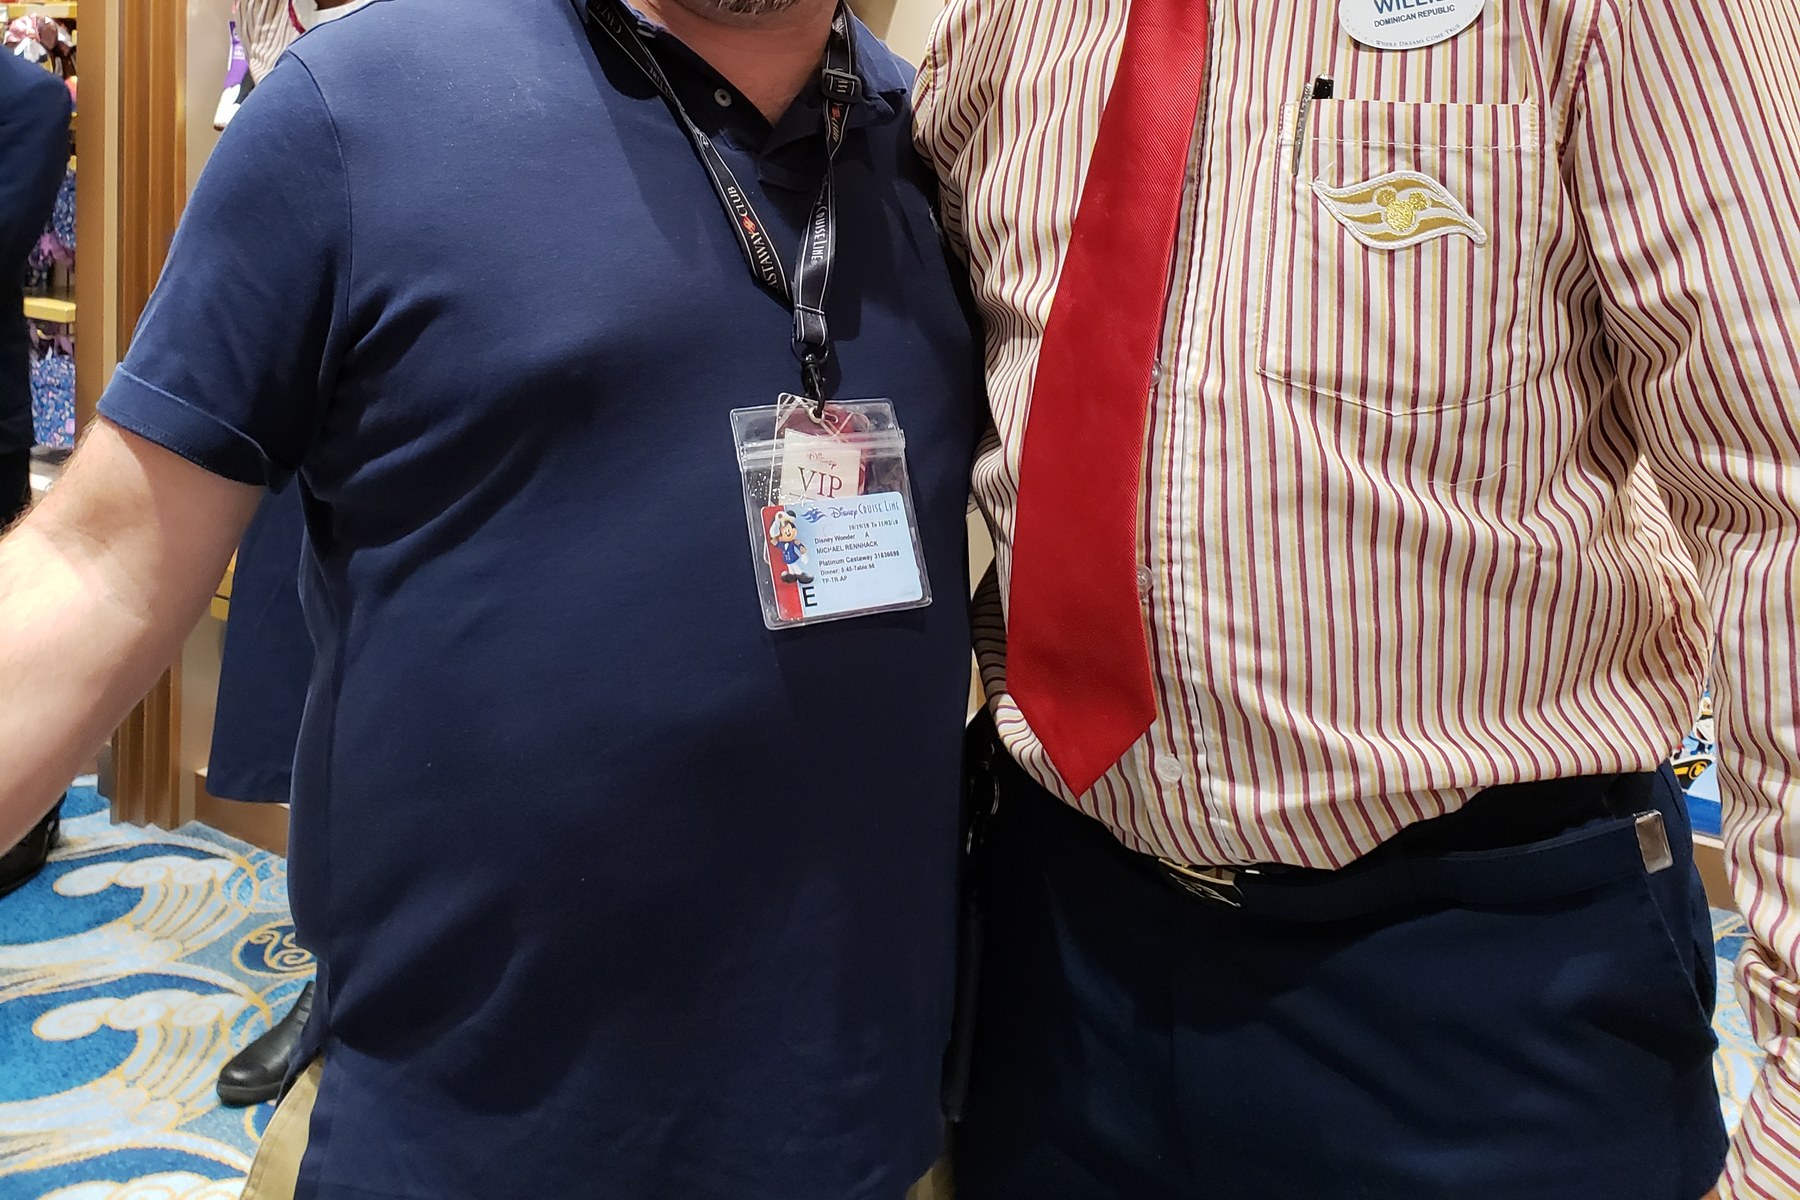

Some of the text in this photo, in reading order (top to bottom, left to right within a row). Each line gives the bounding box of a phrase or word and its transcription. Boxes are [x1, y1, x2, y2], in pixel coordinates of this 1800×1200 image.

[1373, 4, 1456, 28] DOMINICAN REPUBLIC
[727, 186, 748, 217] CLUB
[811, 239, 828, 260] LINE
[798, 466, 843, 499] VIP
[814, 536, 834, 545] Disney
[834, 533, 856, 542] Wonder
[816, 545, 845, 555] MICHAEL
[818, 558, 845, 567] Platinum
[845, 555, 873, 564] Castaway
[802, 585, 818, 608] E
